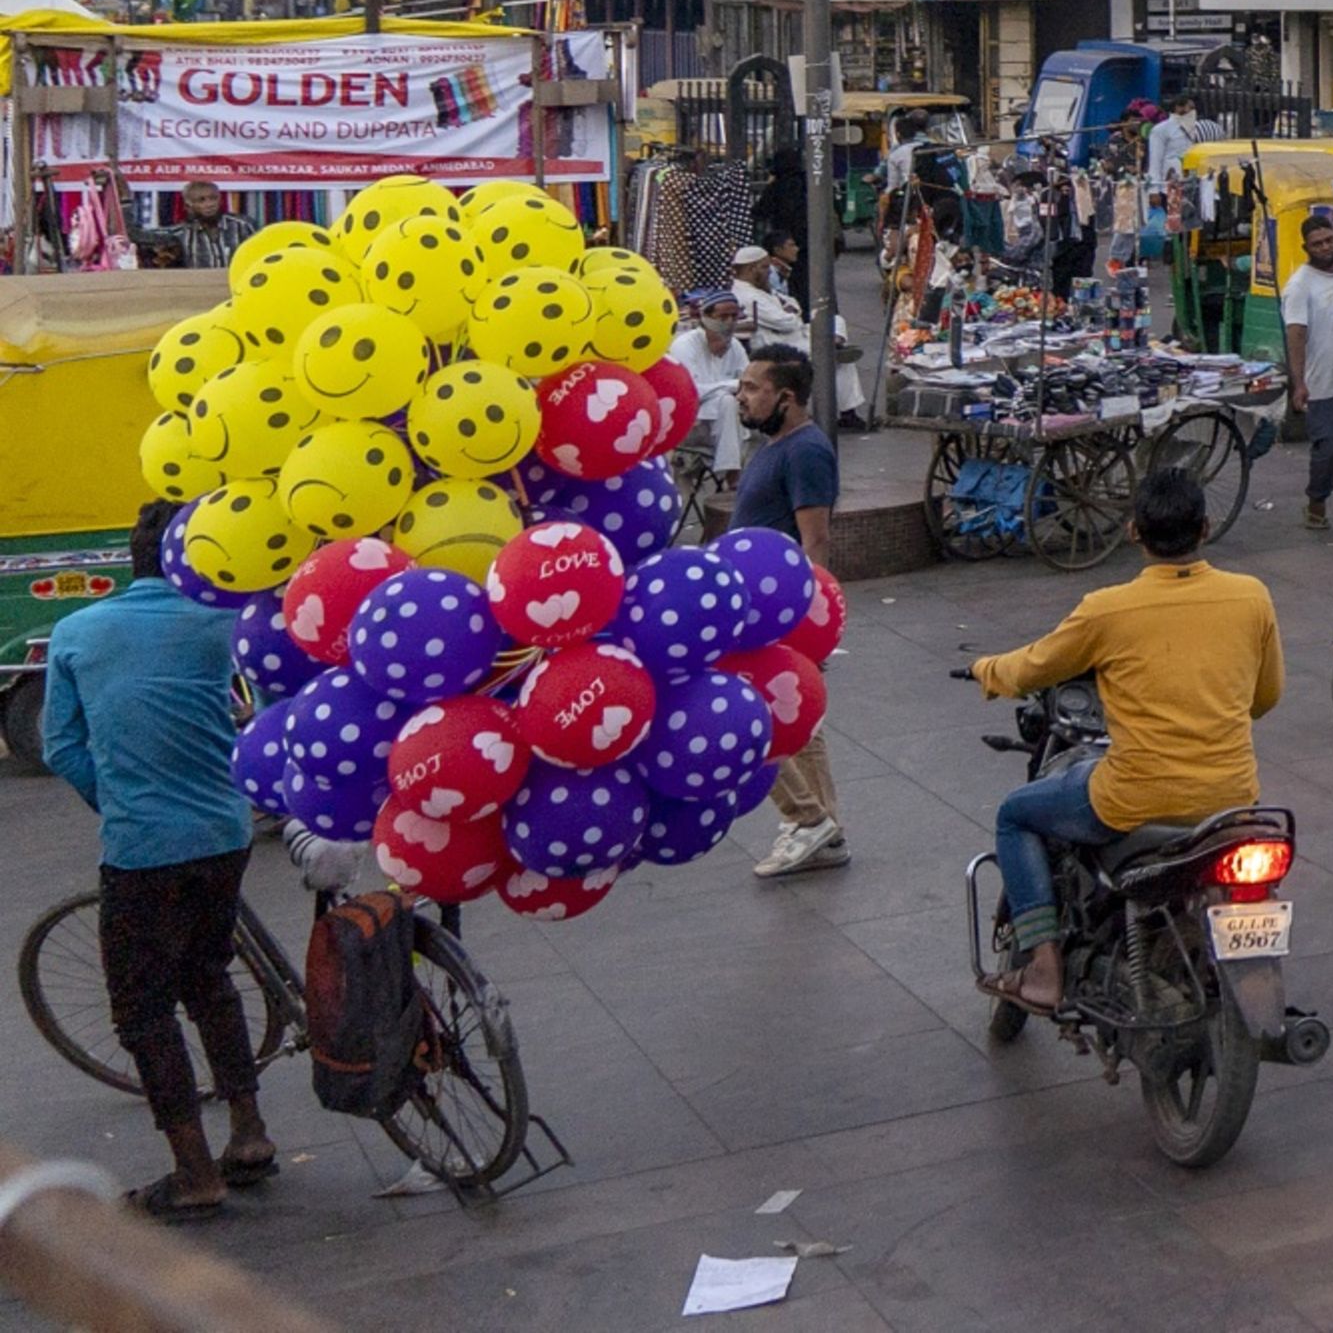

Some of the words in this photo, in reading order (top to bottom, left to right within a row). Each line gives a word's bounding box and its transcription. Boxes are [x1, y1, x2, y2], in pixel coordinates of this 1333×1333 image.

[178, 68, 409, 107] GOLDEN
[145, 119, 270, 139] LEGGINGS
[277, 121, 327, 139] AND
[337, 121, 437, 139] DUPPATA
[547, 363, 596, 406] LOVE
[539, 551, 600, 579] LOVE
[554, 677, 605, 729] LOVE
[394, 753, 442, 790] LOVE
[1228, 931, 1281, 950] 8567
